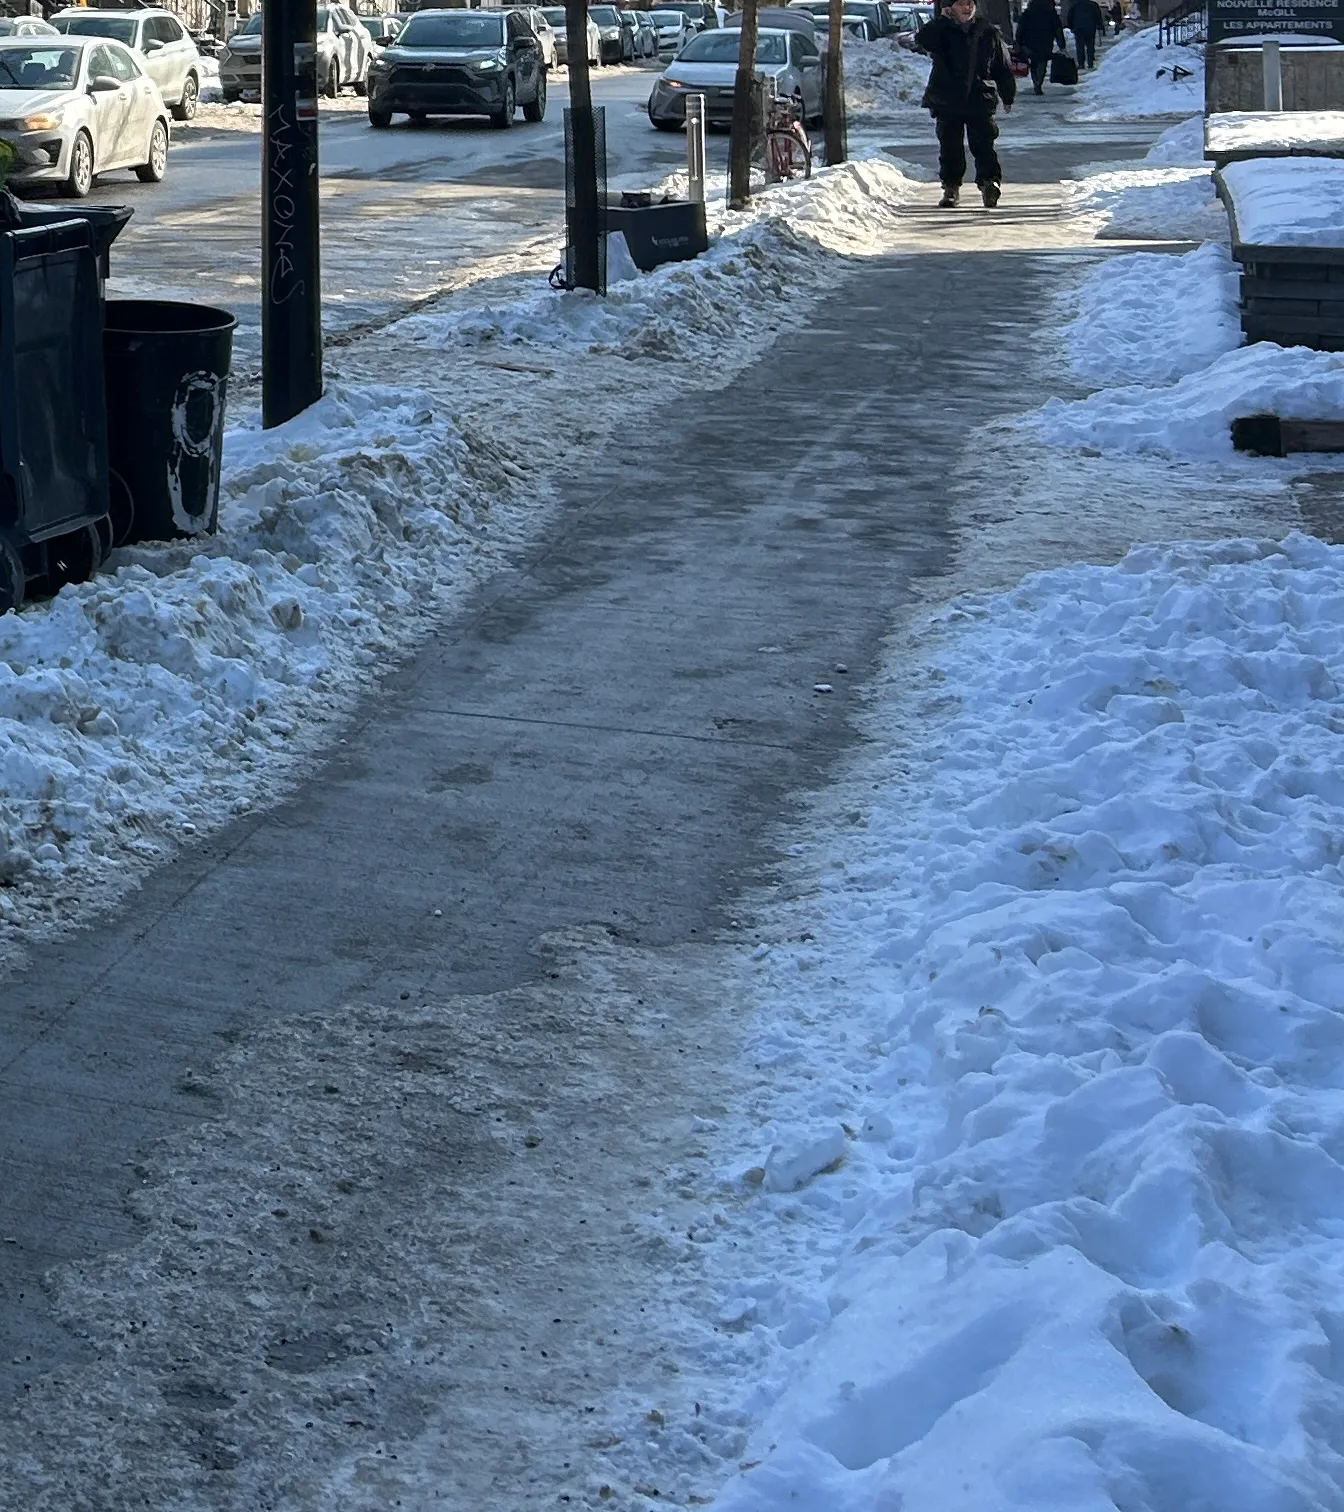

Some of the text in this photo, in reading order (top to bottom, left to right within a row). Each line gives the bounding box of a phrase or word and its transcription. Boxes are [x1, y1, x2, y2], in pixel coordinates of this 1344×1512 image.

[1216, 0, 1274, 8] NOUVELLE
[1223, 20, 1333, 30] LES APPARTEMENTS
